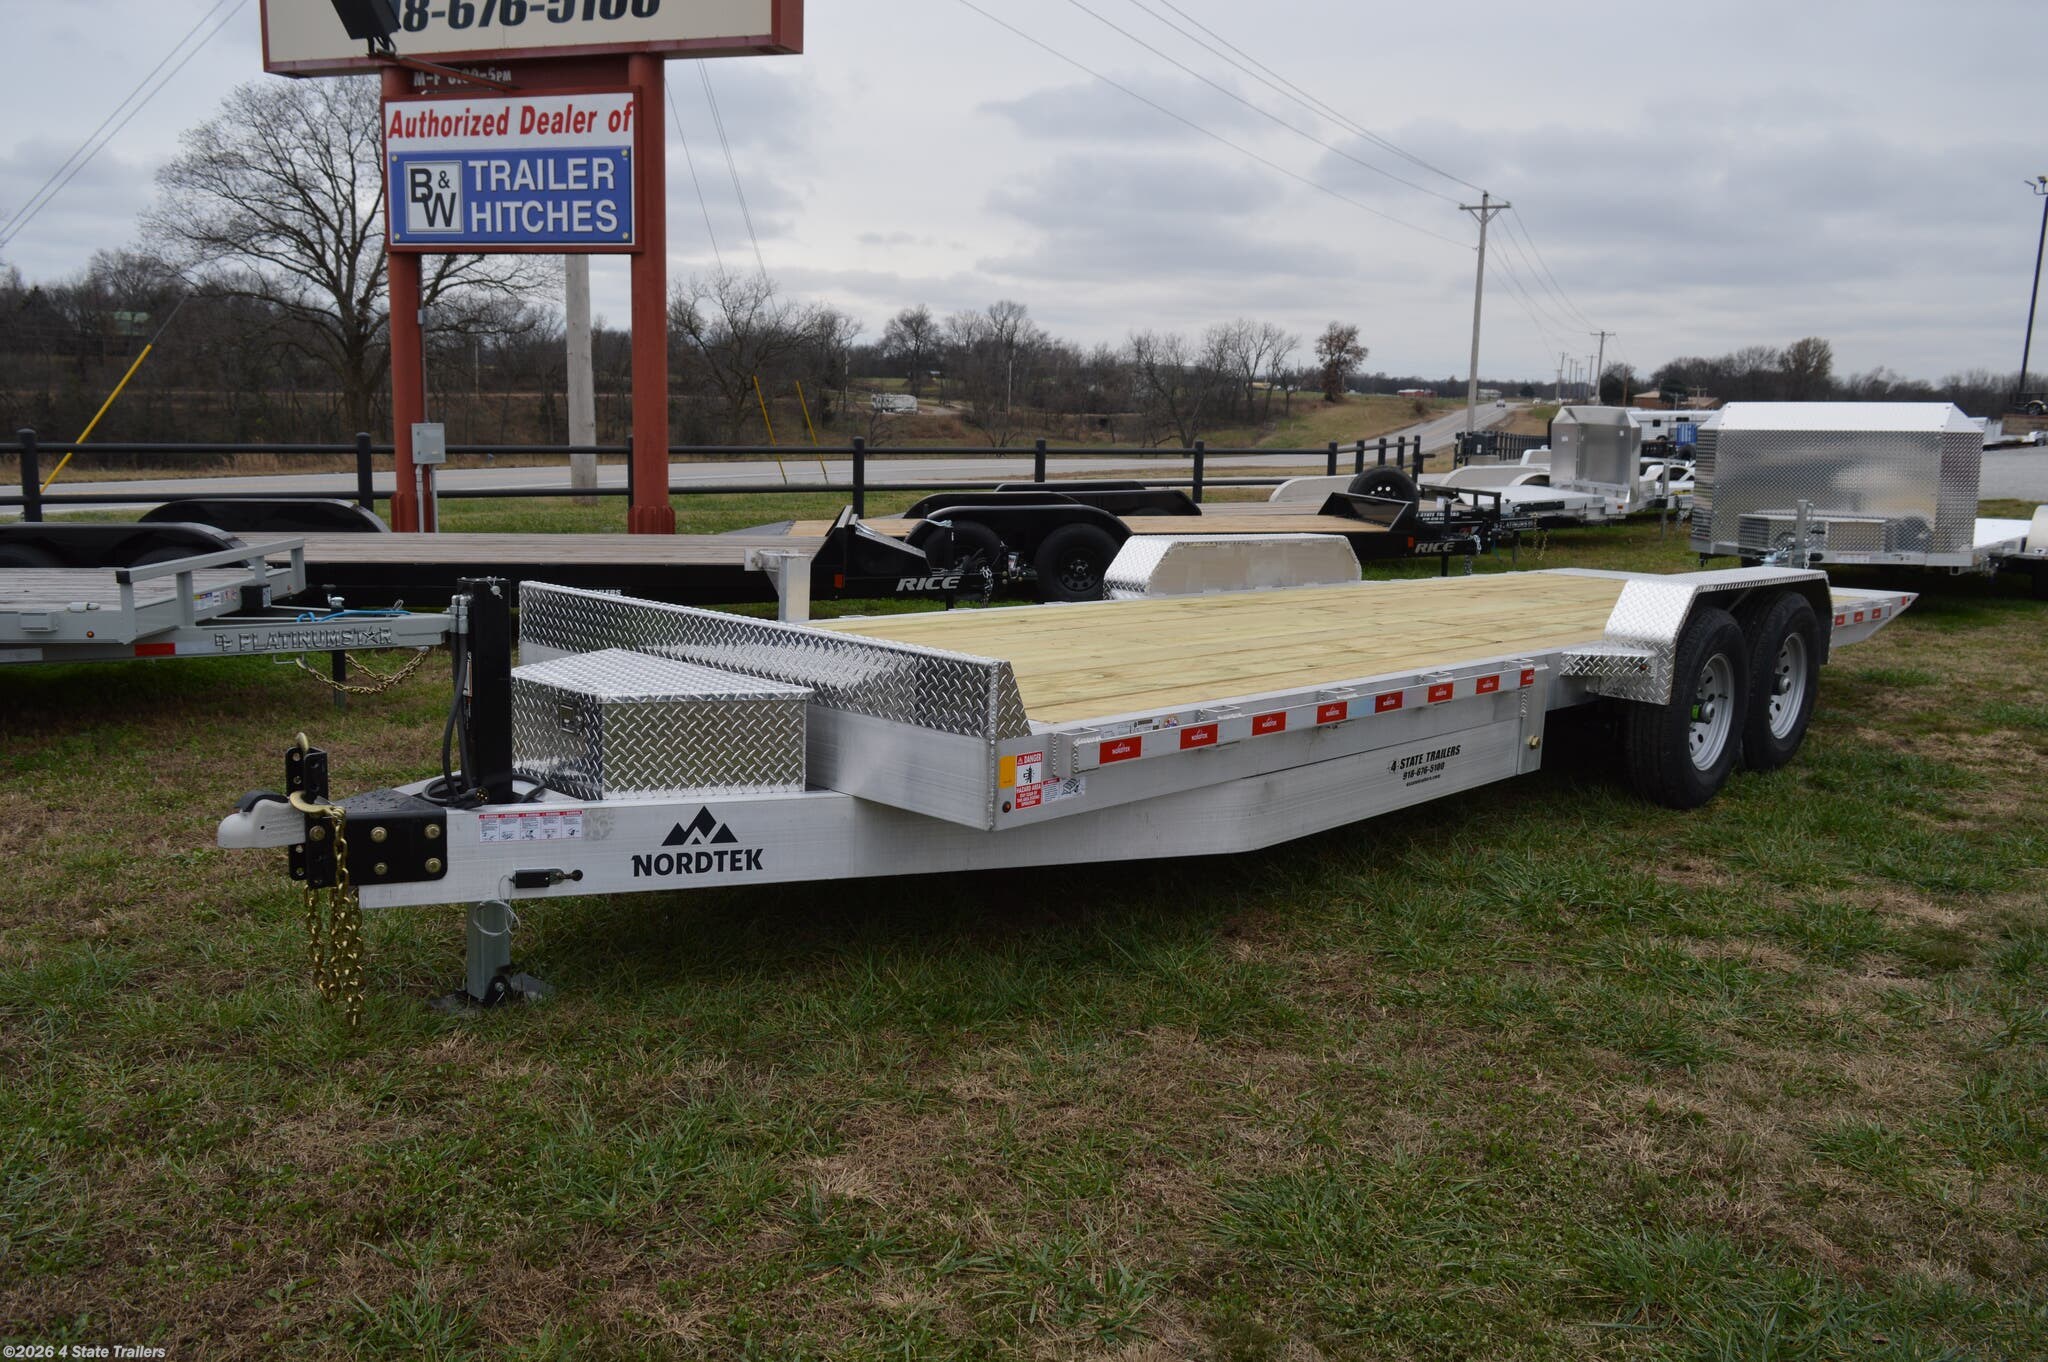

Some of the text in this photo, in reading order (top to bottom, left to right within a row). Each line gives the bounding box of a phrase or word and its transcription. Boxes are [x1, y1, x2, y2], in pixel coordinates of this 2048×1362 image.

[388, 101, 633, 139] Authorized Dealer of
[468, 156, 616, 192] TRAILER
[470, 199, 618, 233] HITCHES
[1414, 541, 1456, 554] RICE
[895, 575, 962, 592] RICE
[1023, 753, 1042, 765] DANGER
[1400, 754, 1424, 769] STATE
[1426, 744, 1462, 762] TRAILERS
[631, 848, 764, 877] NORDTEK
